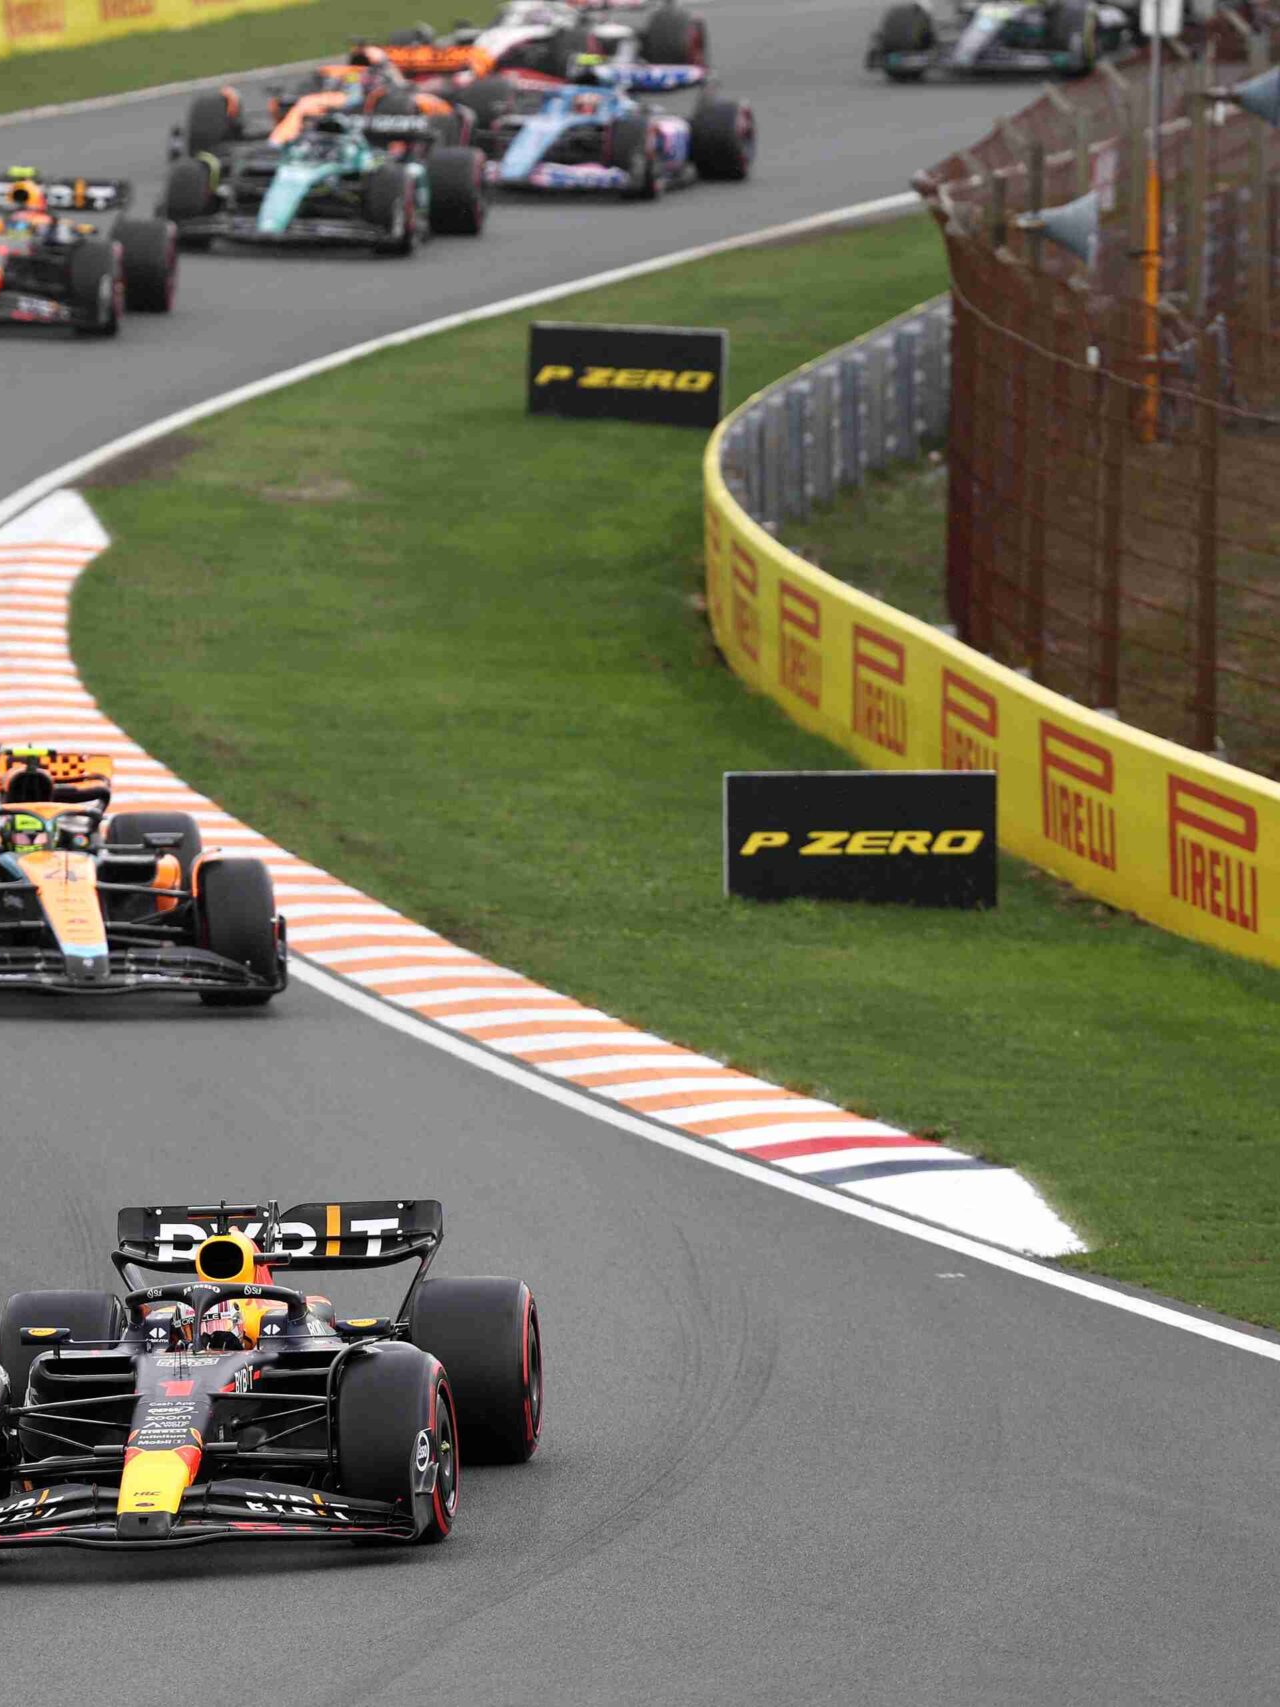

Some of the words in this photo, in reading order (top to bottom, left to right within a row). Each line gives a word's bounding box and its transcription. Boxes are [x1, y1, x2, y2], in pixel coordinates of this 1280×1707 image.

[534, 365, 573, 386] P
[578, 366, 715, 393] ZERO
[852, 622, 906, 757] PIRELLI
[1039, 720, 1116, 872] PIRELLI
[739, 831, 790, 855] P
[799, 830, 985, 855] ZERO
[1168, 773, 1258, 933] PIRELLI
[182, 1314, 220, 1326] ORLE
[160, 1380, 195, 1397] 1
